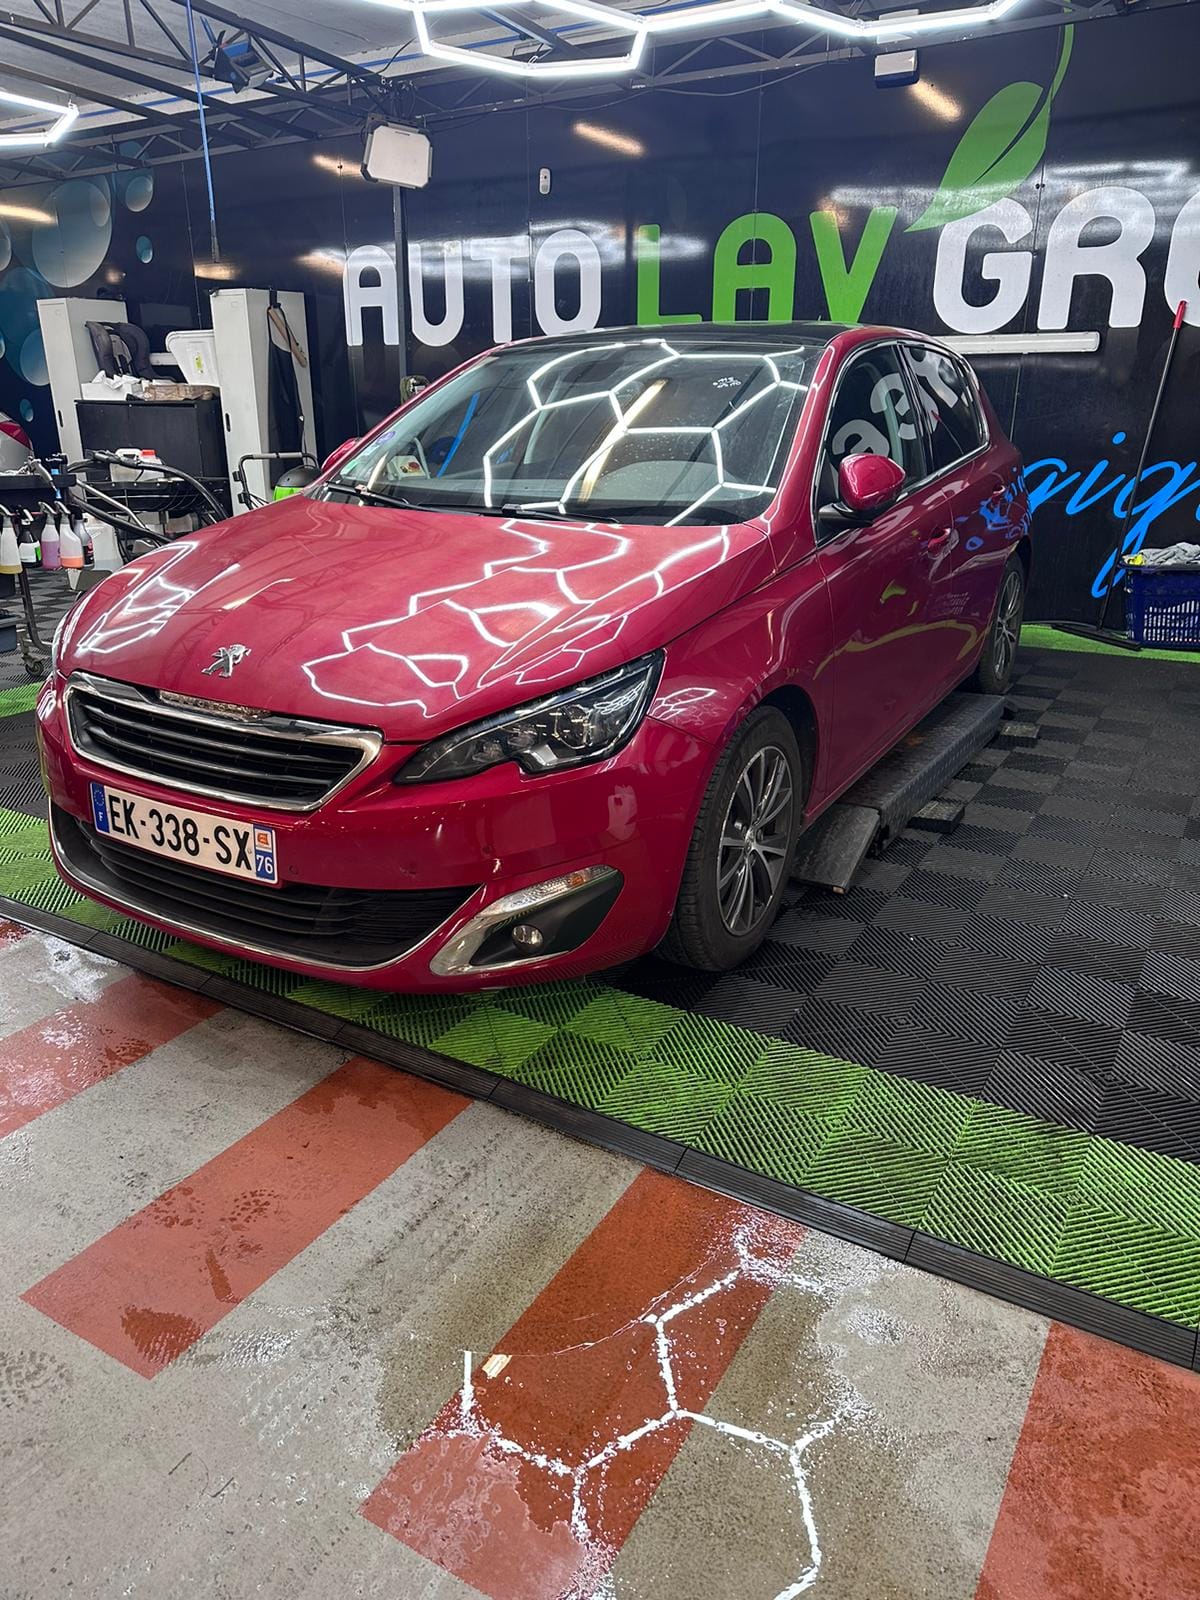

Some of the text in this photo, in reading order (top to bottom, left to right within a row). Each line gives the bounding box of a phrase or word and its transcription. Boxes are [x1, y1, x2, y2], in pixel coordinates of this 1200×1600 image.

[343, 229, 601, 346] AUTO
[637, 206, 899, 327] LAV
[108, 795, 252, 871] EK-338-SX
[256, 854, 273, 875] 76
